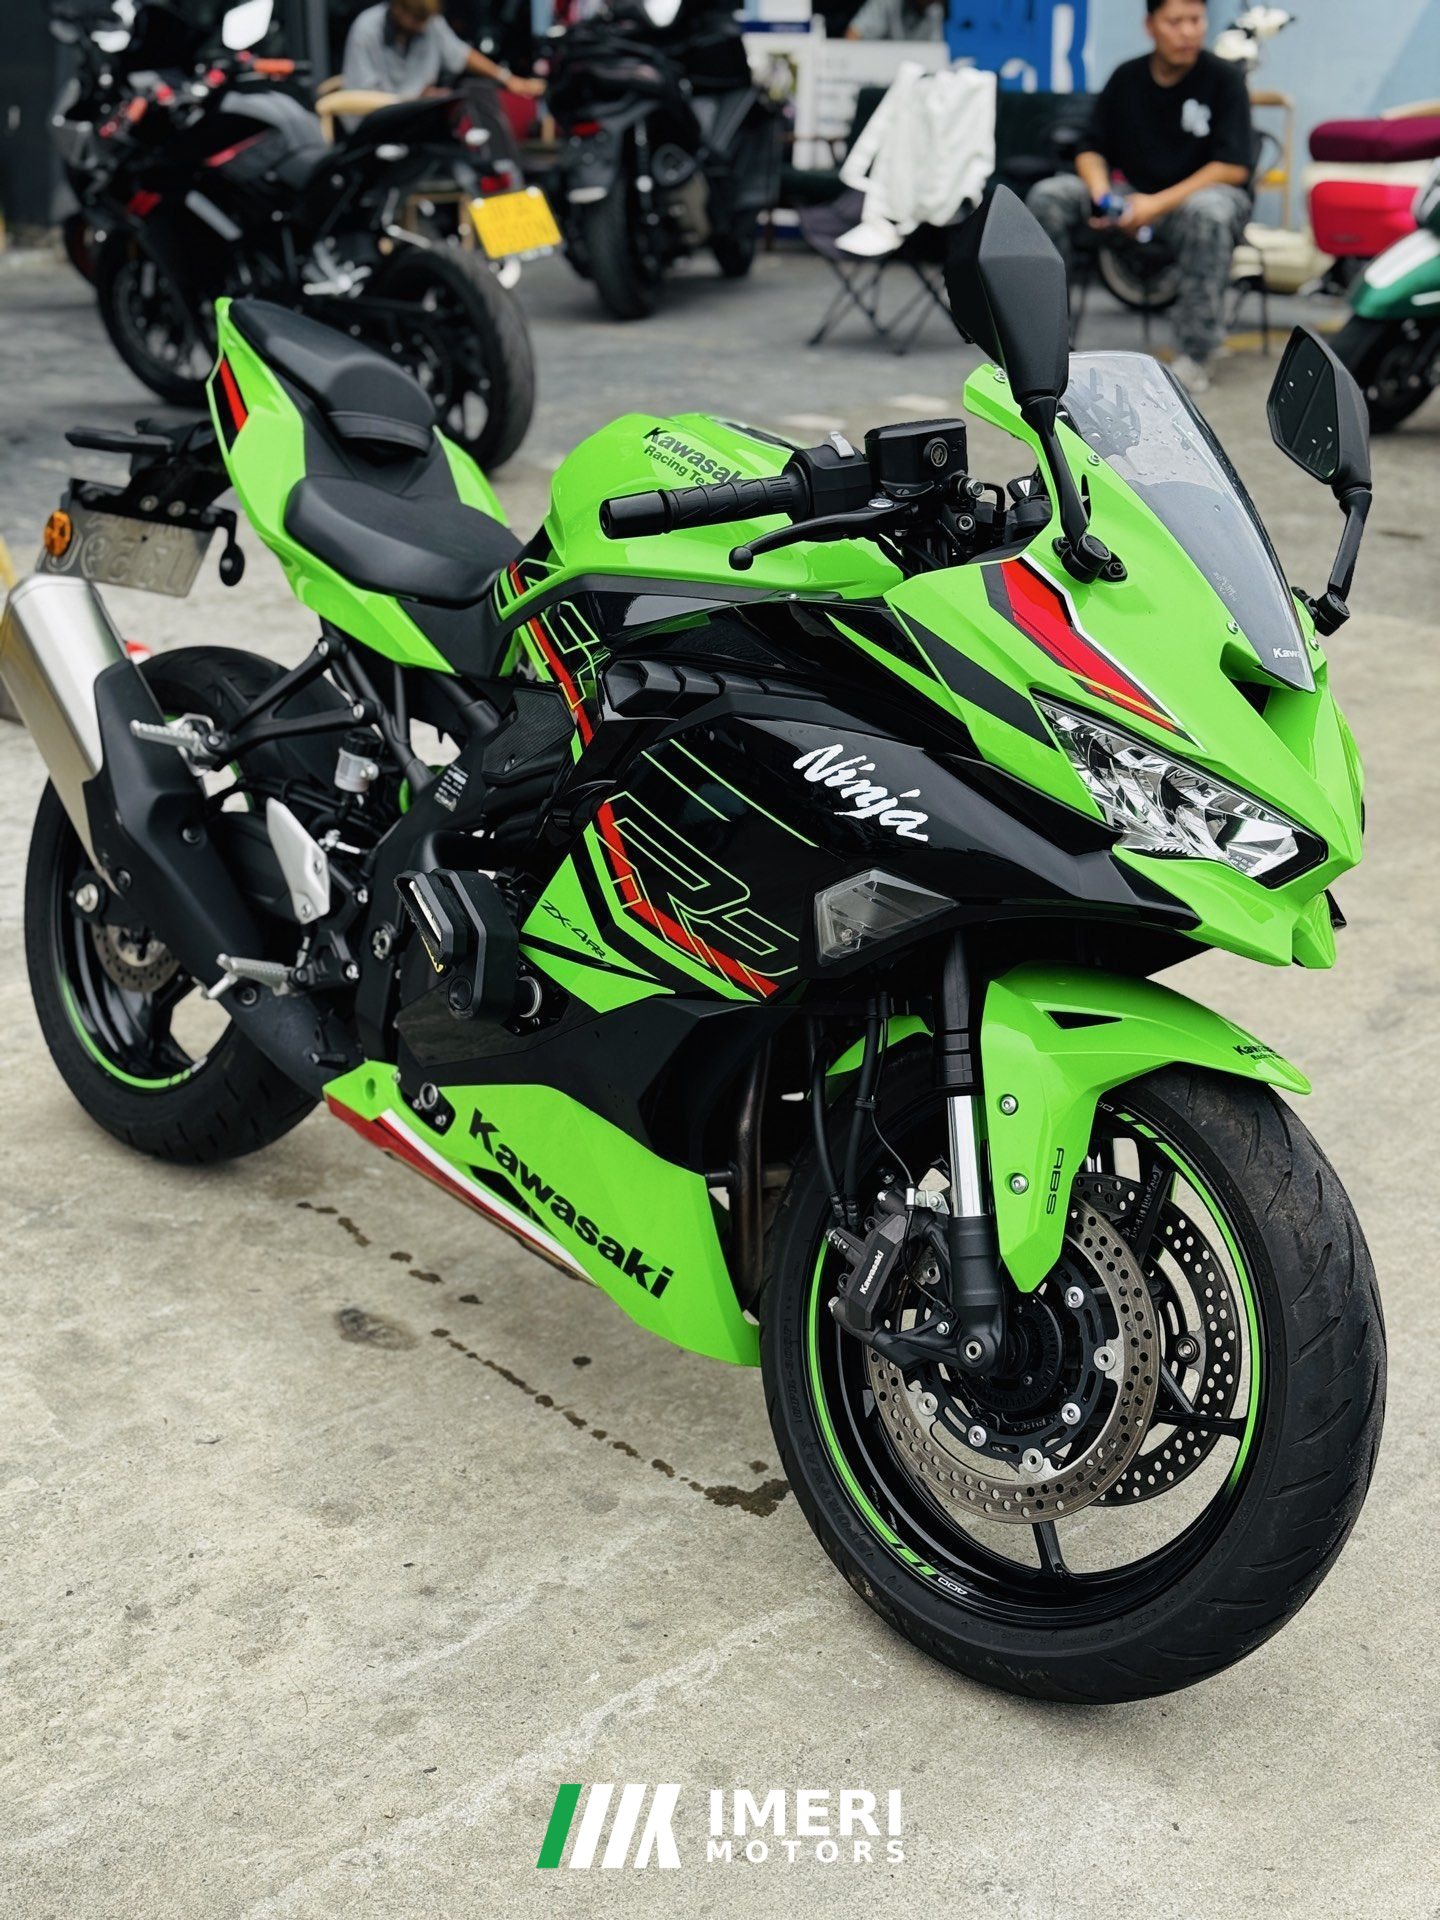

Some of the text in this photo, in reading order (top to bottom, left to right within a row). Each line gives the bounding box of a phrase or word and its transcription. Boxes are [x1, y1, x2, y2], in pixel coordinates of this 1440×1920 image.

[643, 445, 711, 486] Racing Te
[792, 743, 929, 842] Ninja
[469, 1107, 674, 1299] Kawasaki
[1046, 1147, 1065, 1215] ABS
[859, 1249, 885, 1295] Kawasaki
[938, 1577, 968, 1595] 400
